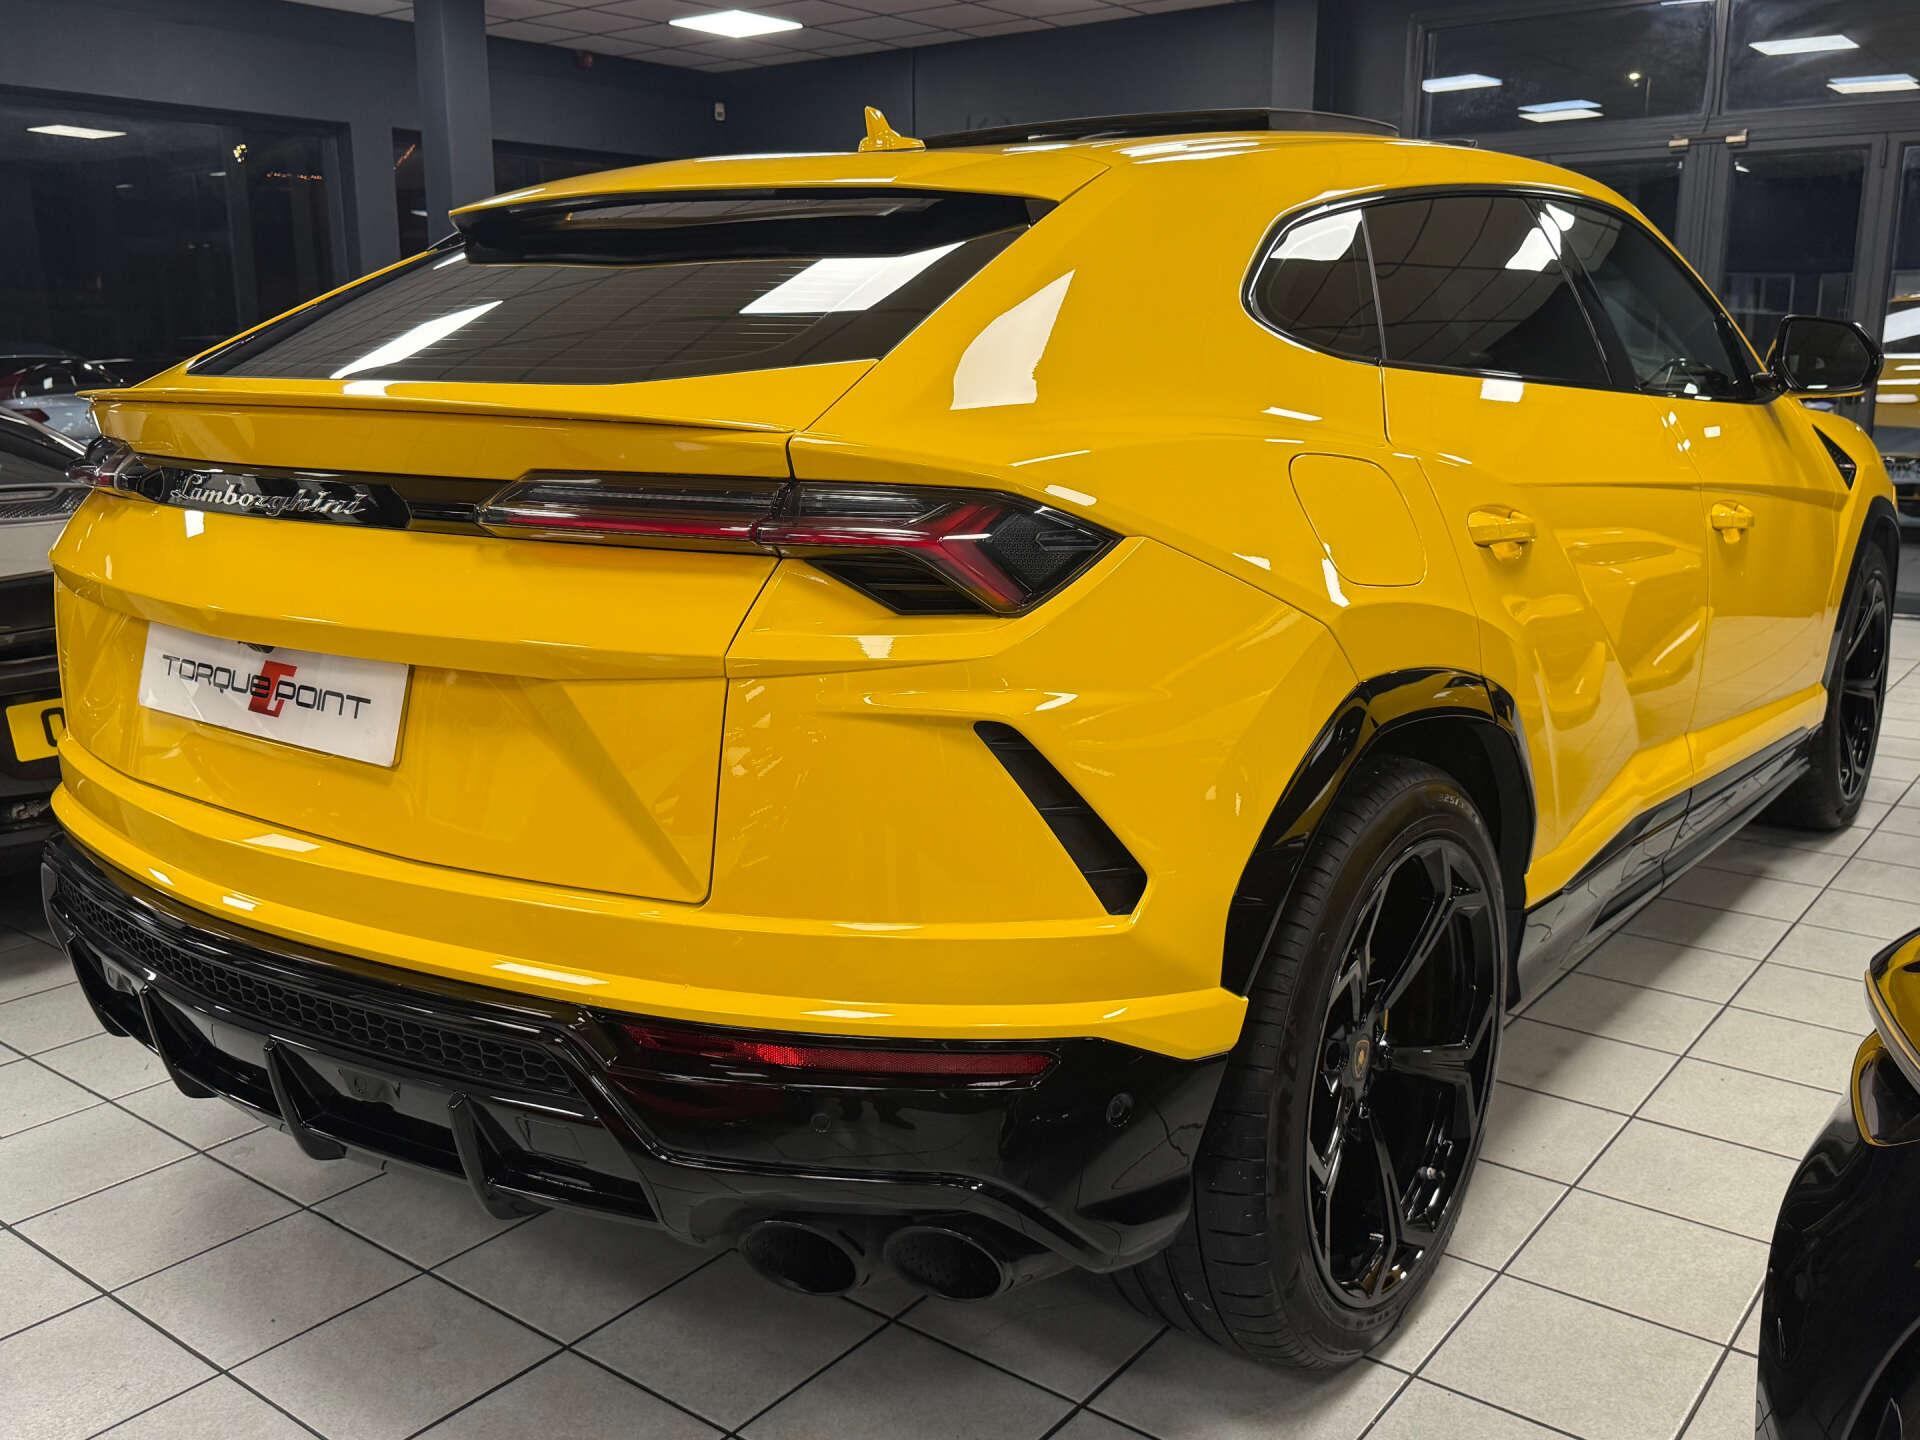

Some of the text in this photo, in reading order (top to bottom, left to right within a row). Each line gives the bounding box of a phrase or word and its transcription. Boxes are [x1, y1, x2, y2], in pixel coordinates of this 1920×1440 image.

[171, 473, 368, 517] Lamborghini
[162, 654, 372, 719] TORQUE POINT
